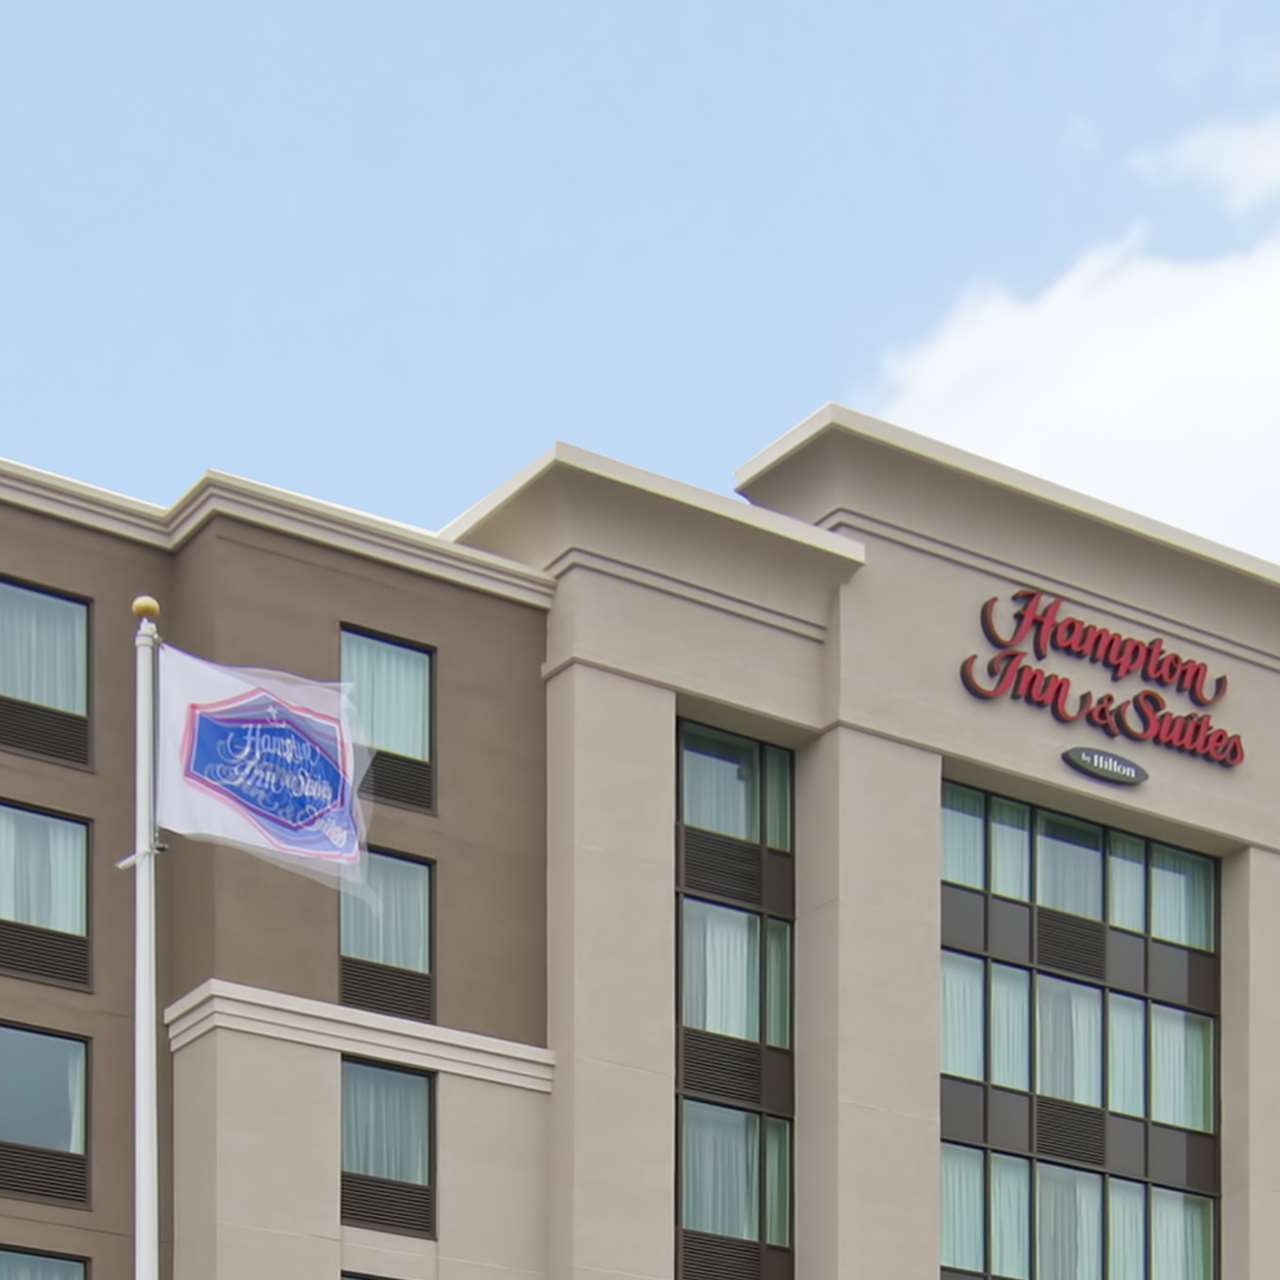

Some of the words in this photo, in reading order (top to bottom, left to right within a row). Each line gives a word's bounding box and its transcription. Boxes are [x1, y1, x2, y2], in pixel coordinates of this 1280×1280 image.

[980, 588, 1228, 706] Hampton
[959, 650, 1093, 724] Inn
[1085, 692, 1120, 739] &
[1114, 689, 1245, 768] Suites
[1093, 754, 1136, 779] Hilton
